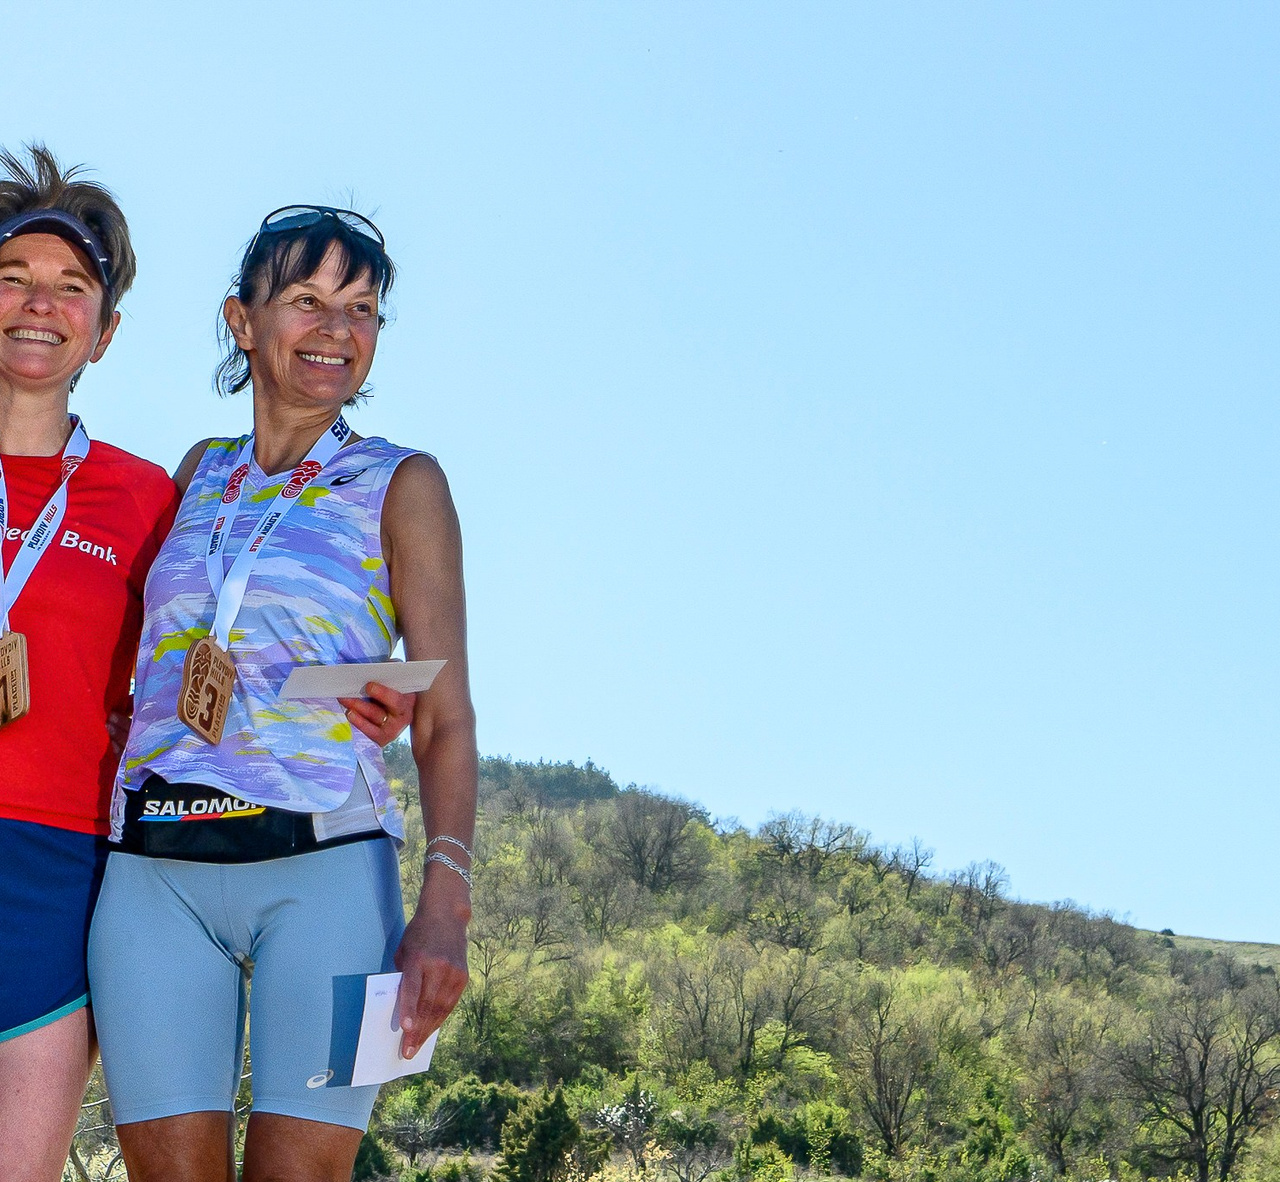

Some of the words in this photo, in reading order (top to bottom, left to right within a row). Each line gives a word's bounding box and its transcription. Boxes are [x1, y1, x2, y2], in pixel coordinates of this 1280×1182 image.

[27, 521, 48, 549] PLOVDIV
[44, 504, 58, 524] HILLS
[60, 530, 117, 566] Bank
[198, 683, 217, 732] 3
